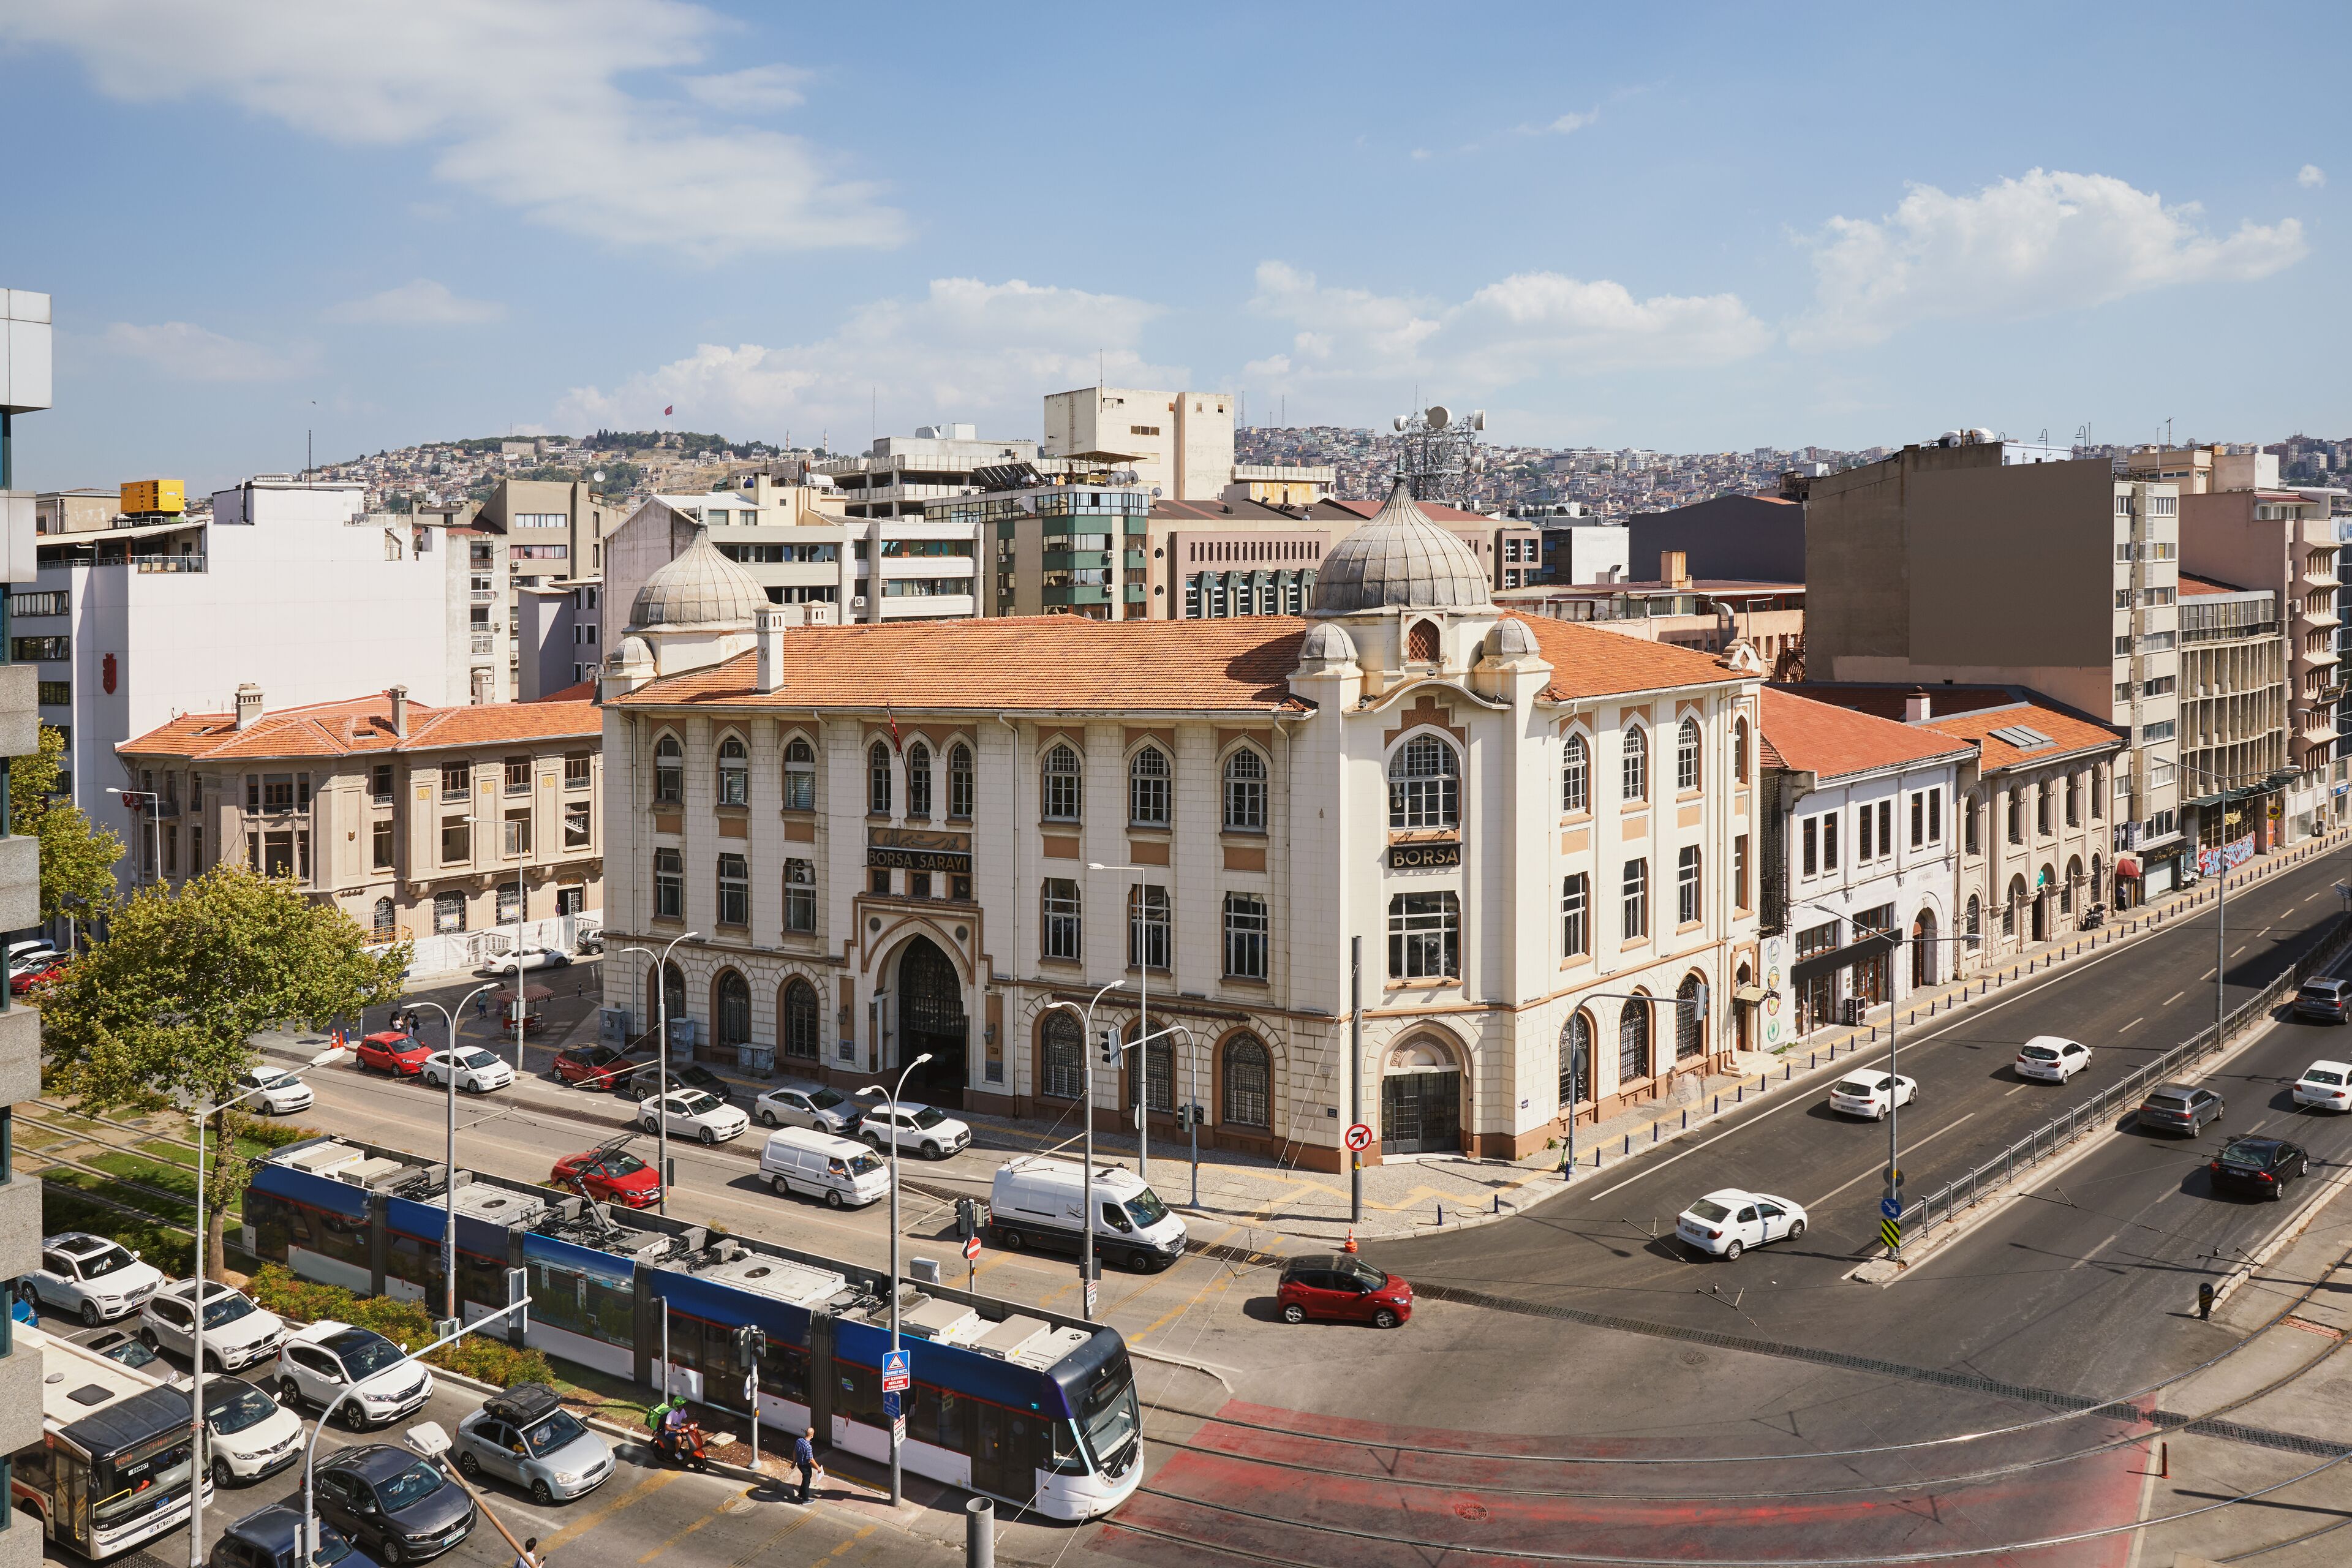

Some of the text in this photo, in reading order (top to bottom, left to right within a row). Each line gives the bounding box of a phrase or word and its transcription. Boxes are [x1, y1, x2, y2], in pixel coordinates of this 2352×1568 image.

[869, 851, 968, 871] BORSA SARAYI
[1393, 848, 1459, 867] BORSA
[895, 1426, 905, 1436] KAPAN
[132, 1463, 149, 1474] ESHOT
[148, 1506, 173, 1520] ESHOT
